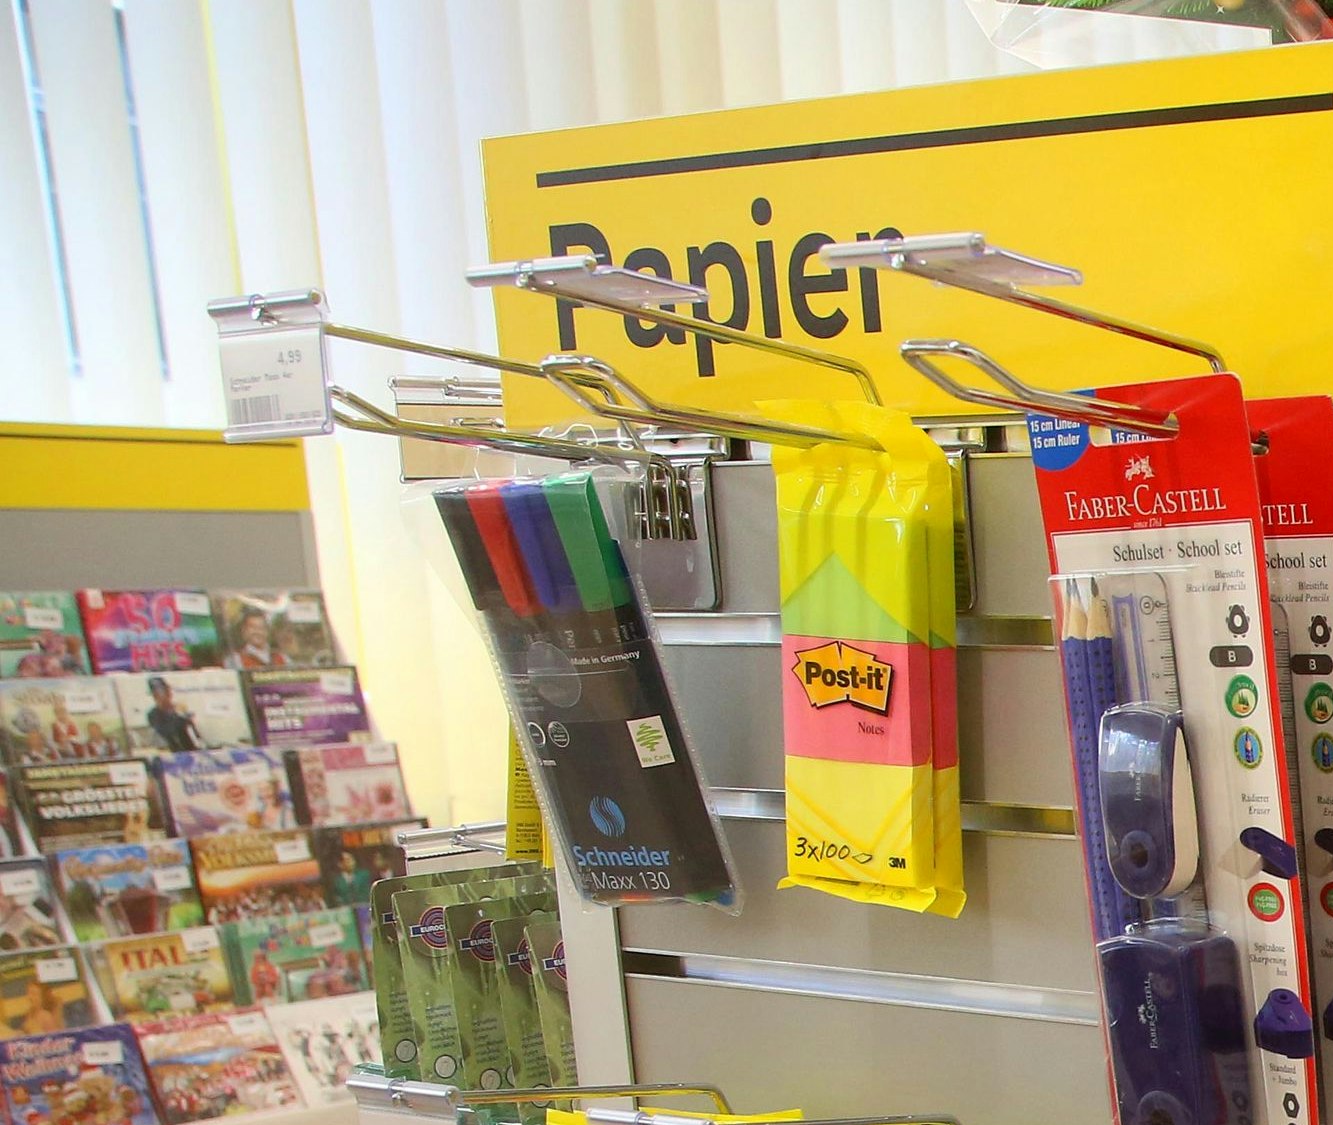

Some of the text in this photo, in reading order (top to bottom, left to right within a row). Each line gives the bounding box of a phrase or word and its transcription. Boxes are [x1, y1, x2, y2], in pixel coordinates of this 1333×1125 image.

[548, 197, 905, 377] Papier
[1057, 432, 1081, 446] Ruler
[1064, 484, 1227, 521] FABER-CASTELL
[1112, 539, 1243, 563] Schulset School set
[1309, 552, 1328, 568] set
[600, 649, 641, 668] Germany
[1228, 649, 1237, 662] B
[1308, 658, 1318, 671] B
[804, 660, 889, 693] Post-it
[857, 719, 886, 737] Notes
[573, 844, 671, 869] Schneider
[793, 836, 851, 863] 3x100
[888, 856, 907, 869] 3M
[591, 869, 671, 892] Maxx 130
